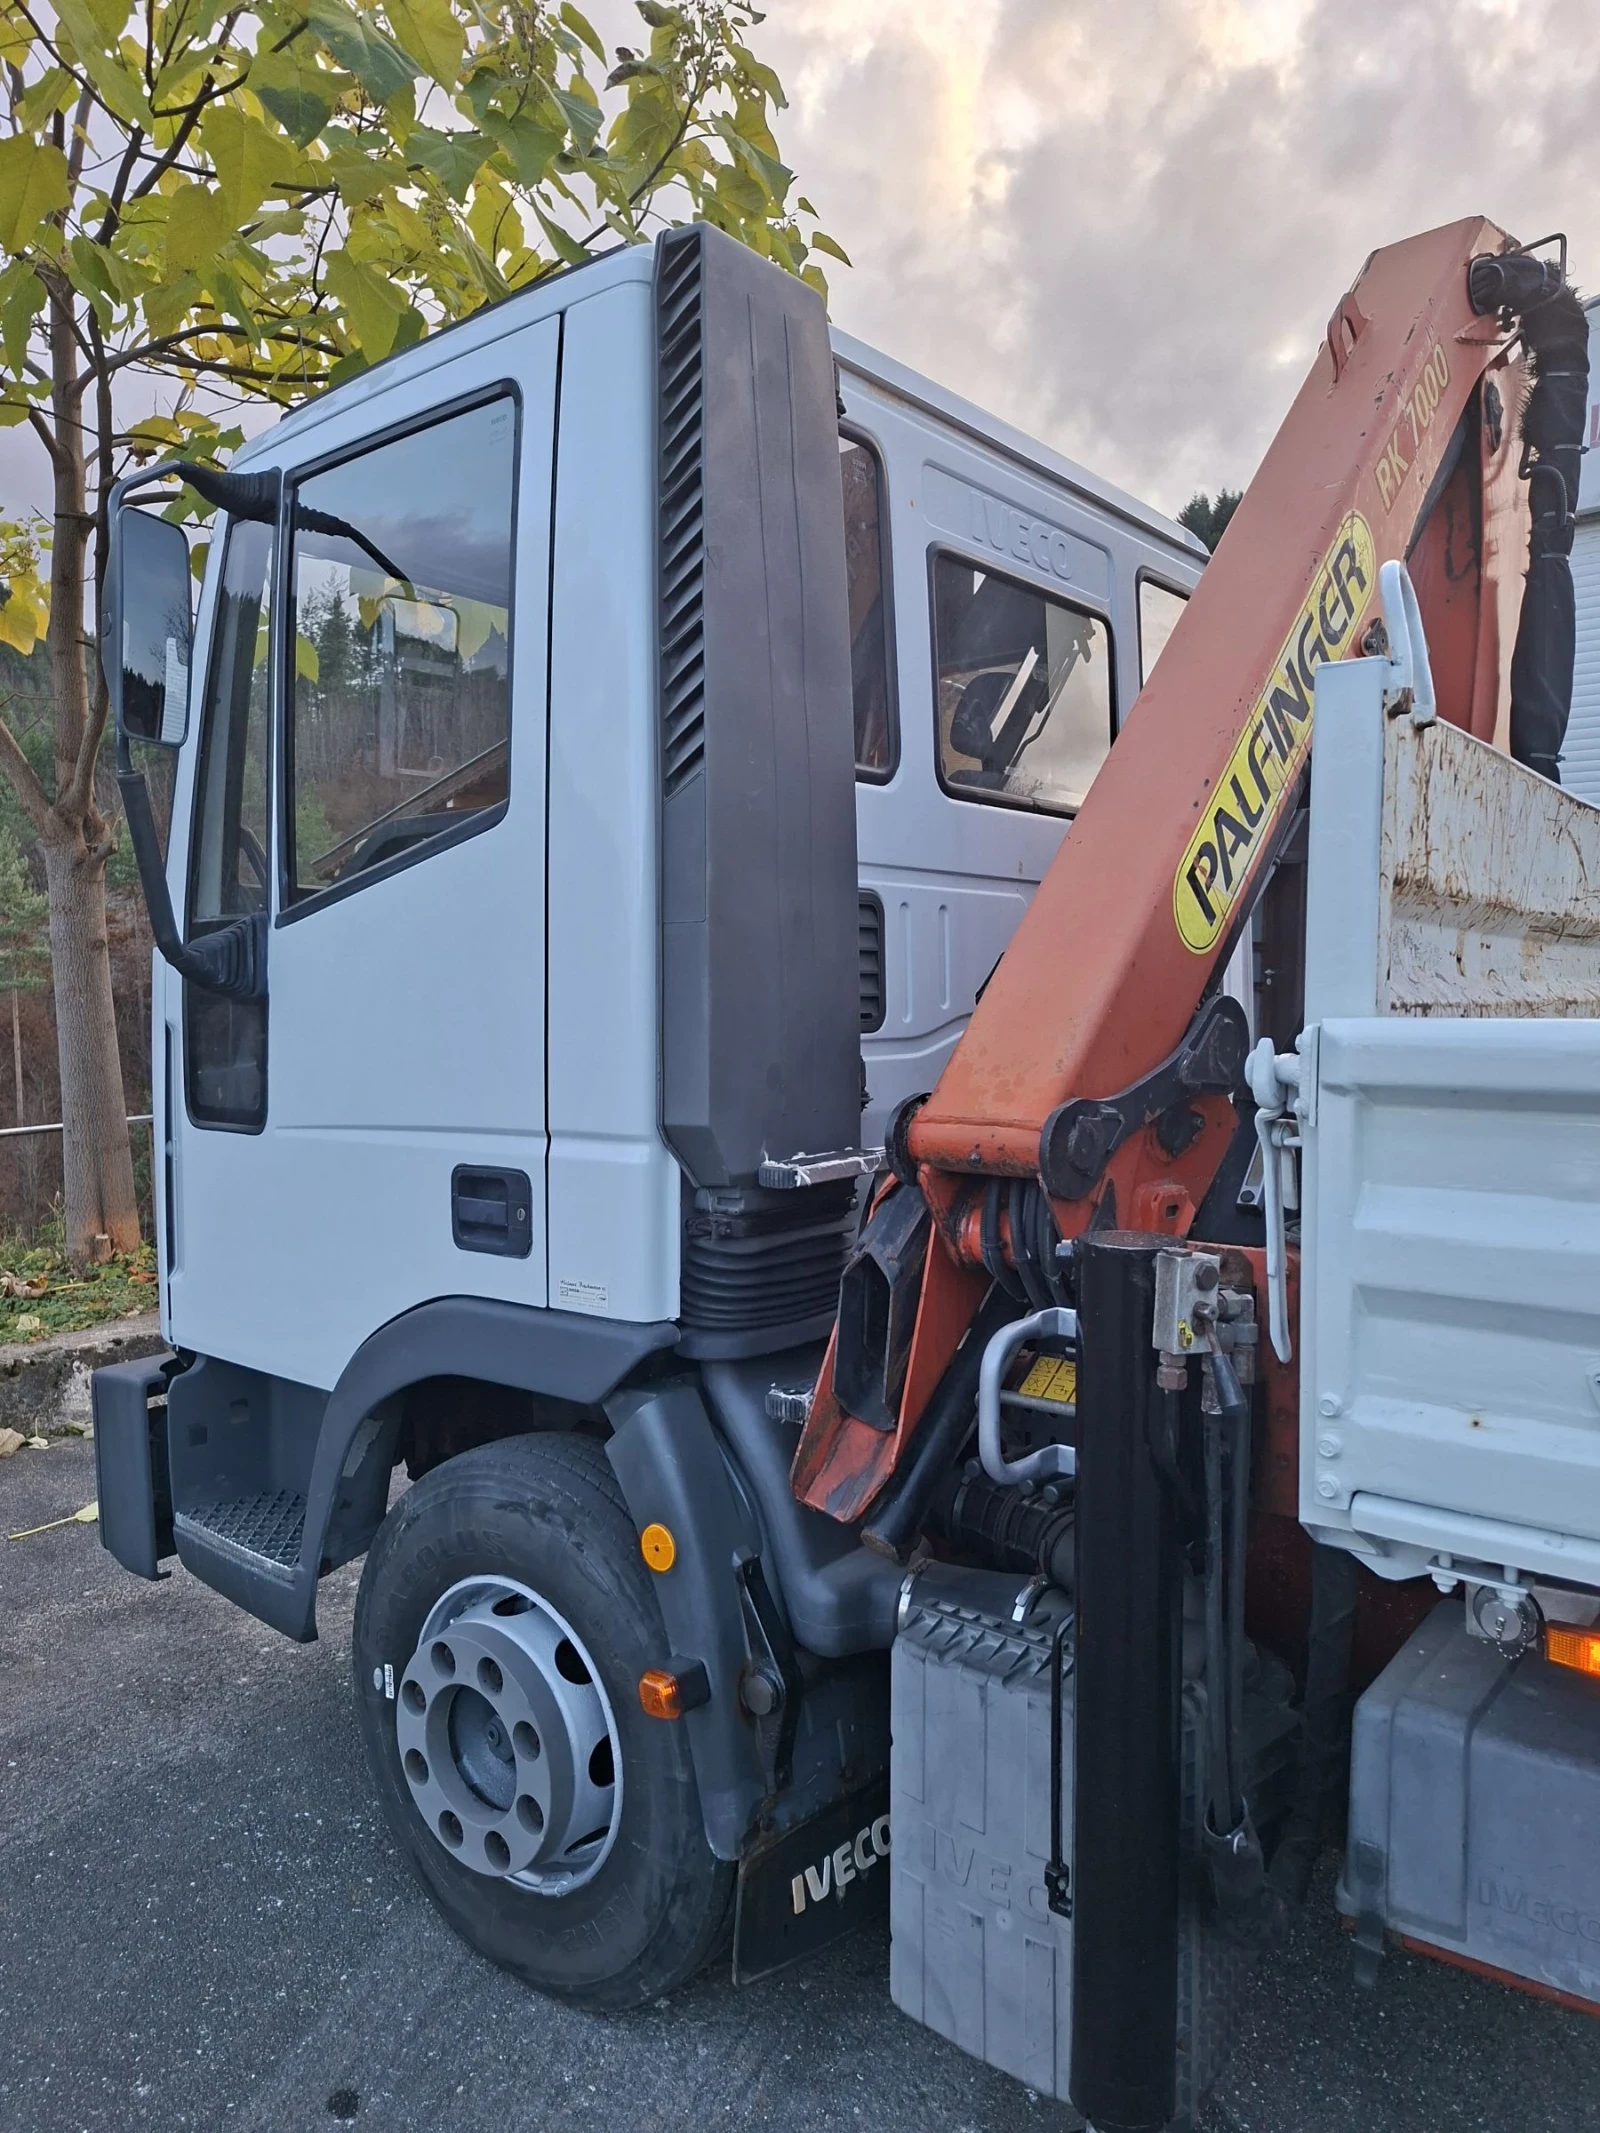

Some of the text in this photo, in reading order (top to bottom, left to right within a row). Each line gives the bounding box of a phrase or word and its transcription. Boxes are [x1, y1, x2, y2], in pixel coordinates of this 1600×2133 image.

[1375, 343, 1449, 510] PK 7000
[970, 489, 1074, 580] IVECO
[1185, 538, 1368, 927] PALFINGER
[790, 1813, 891, 1915] IVECO
[920, 1819, 1051, 1926] IVEC
[1478, 1878, 1600, 1944] IVECO
